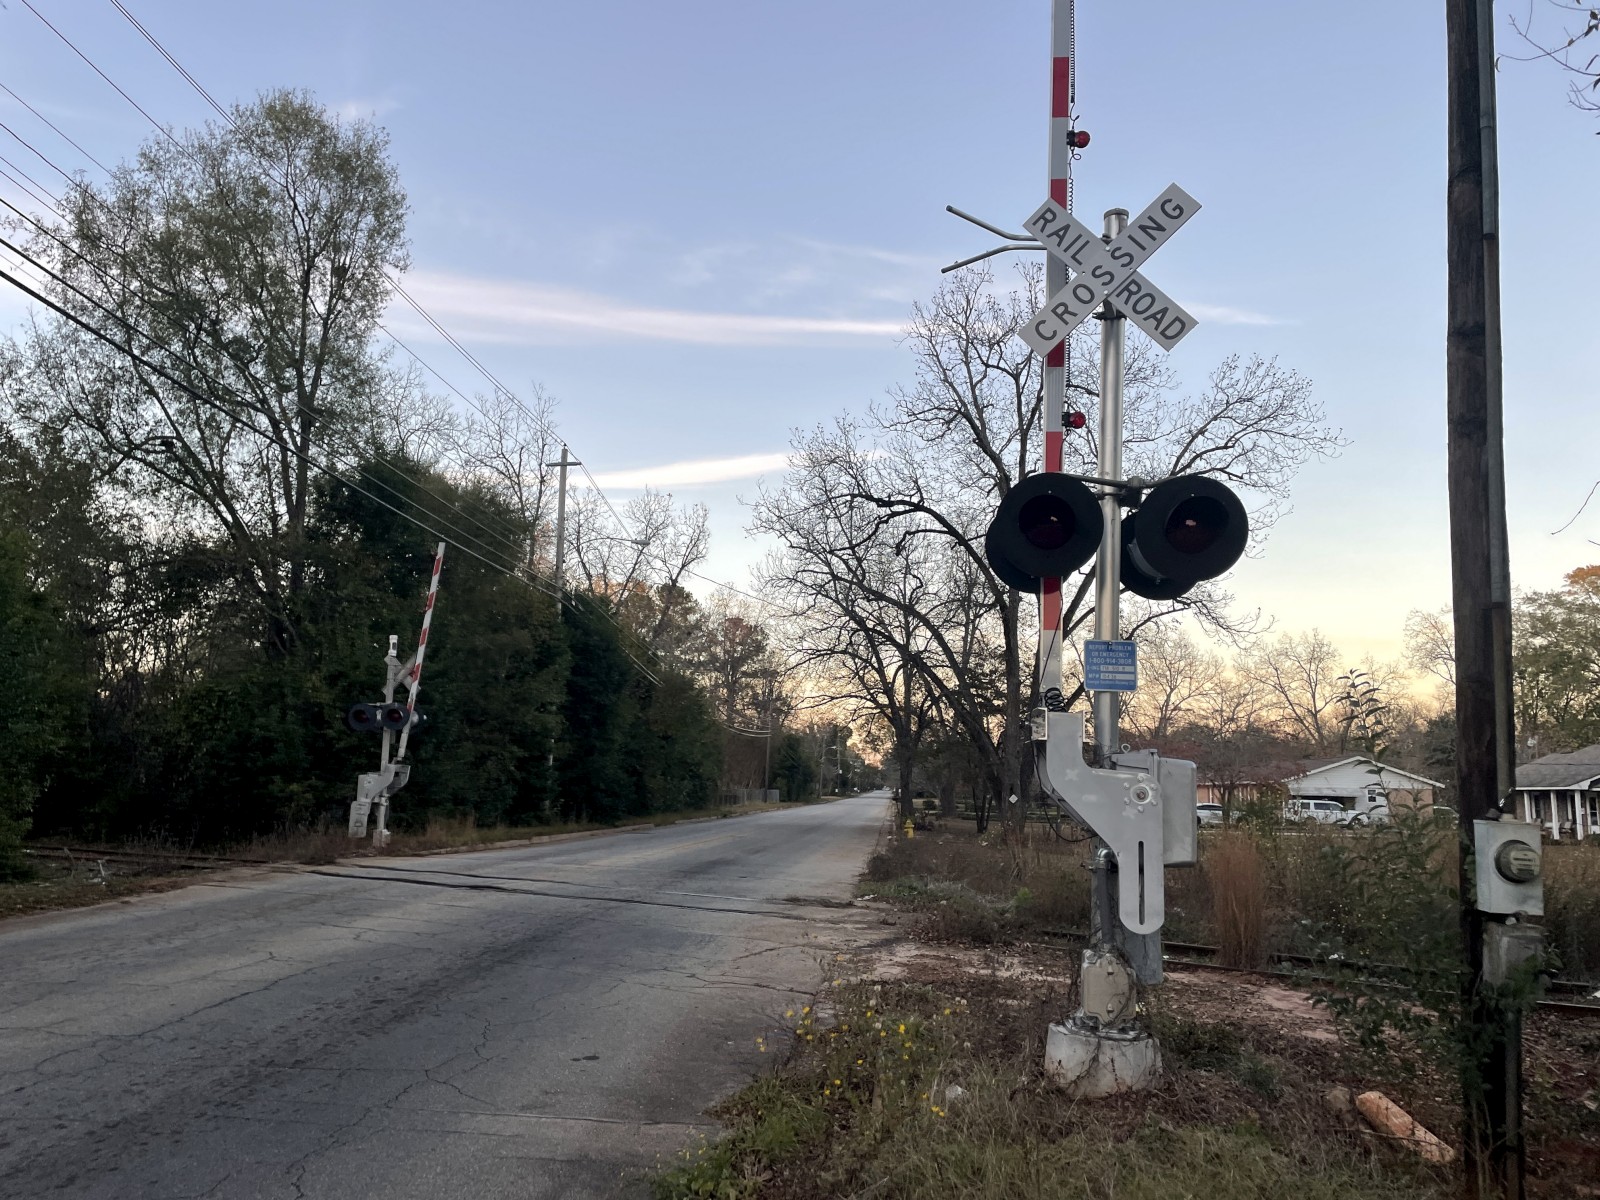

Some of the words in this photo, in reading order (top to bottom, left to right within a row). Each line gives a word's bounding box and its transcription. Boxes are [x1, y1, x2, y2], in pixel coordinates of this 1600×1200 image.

[1032, 207, 1090, 266] RAIL
[1035, 198, 1185, 341] CROSSING
[1115, 278, 1186, 340] ROAD
